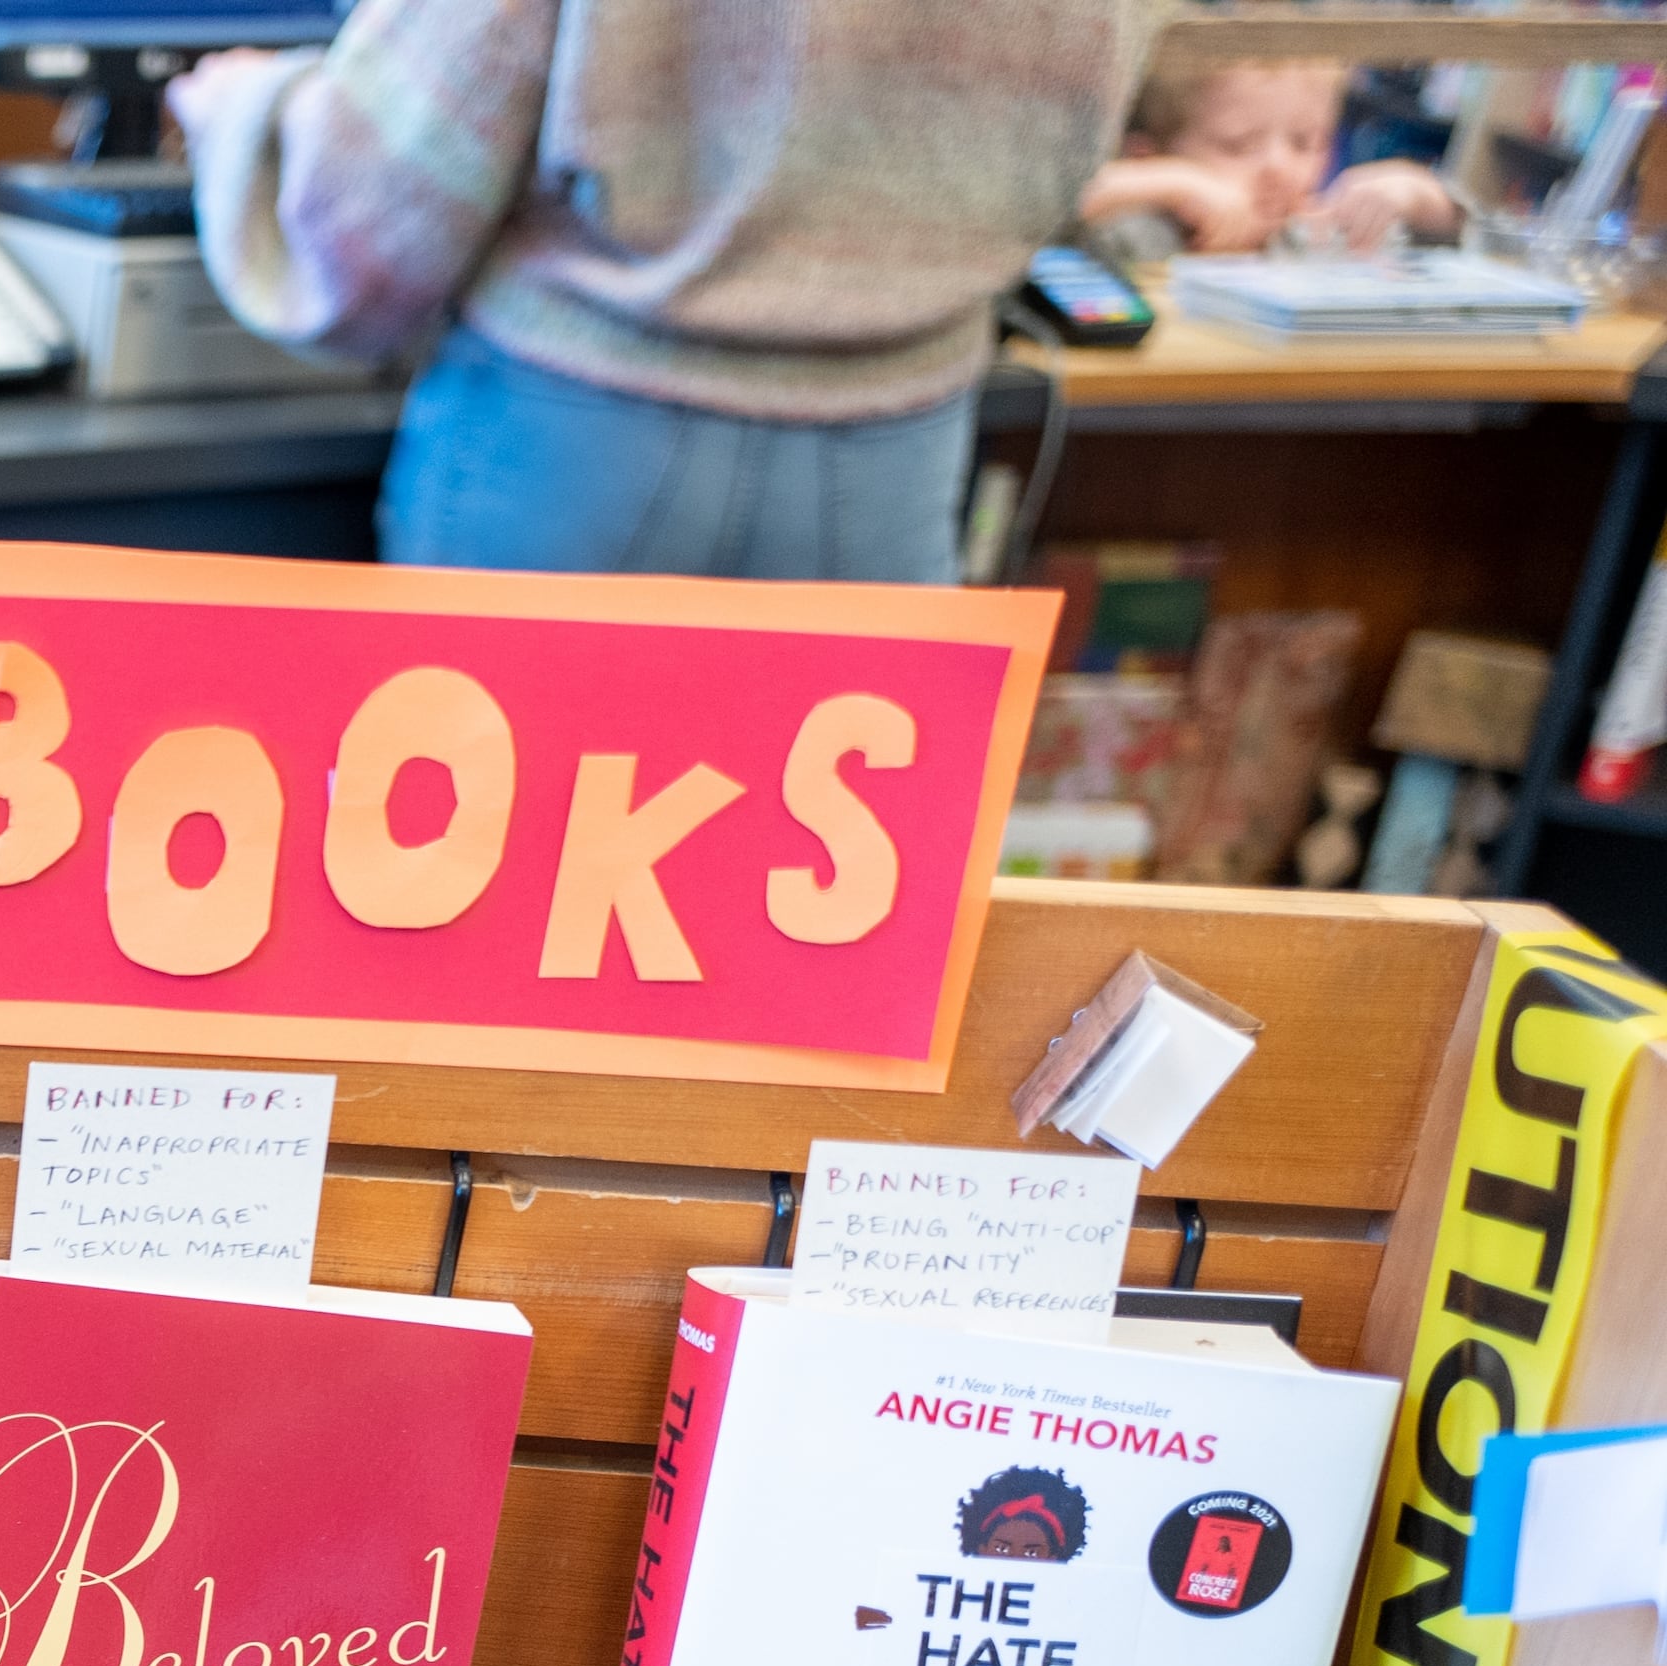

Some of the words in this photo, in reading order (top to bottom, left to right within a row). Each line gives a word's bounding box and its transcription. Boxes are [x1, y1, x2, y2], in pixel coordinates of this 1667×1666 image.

[46, 1087, 192, 1112] BANNED
[222, 1088, 303, 1111] FOR:
[827, 1166, 979, 1199] BANNED
[1009, 1174, 1086, 1199] FOR:
[876, 1392, 1012, 1436] ANGIE
[1029, 1410, 1220, 1465] THOMAS
[1188, 1496, 1249, 1517] COMING
[1248, 1504, 1278, 1528] 2021
[1188, 1572, 1237, 1589] CONCRETE
[1188, 1582, 1231, 1600] ROSE
[917, 1574, 1035, 1626] THE
